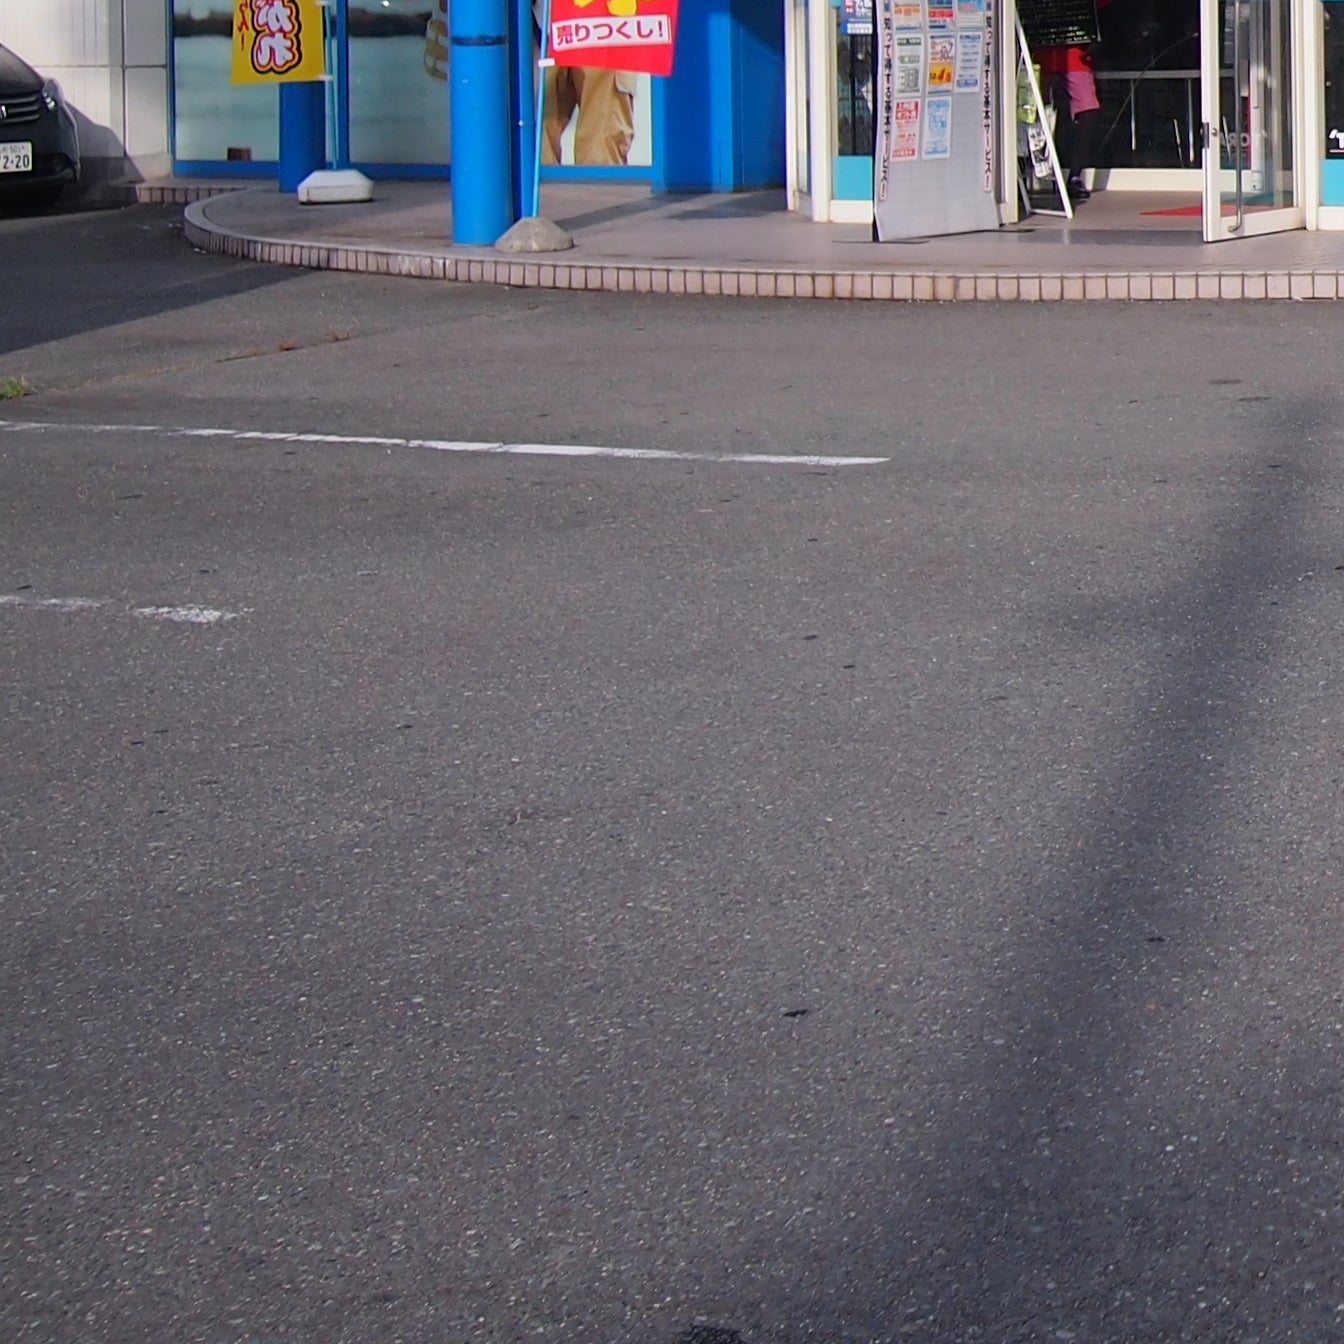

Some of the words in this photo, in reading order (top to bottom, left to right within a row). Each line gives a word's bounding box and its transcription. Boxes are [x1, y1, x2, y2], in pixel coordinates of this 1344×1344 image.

[556, 17, 667, 46] 売りつくし!
